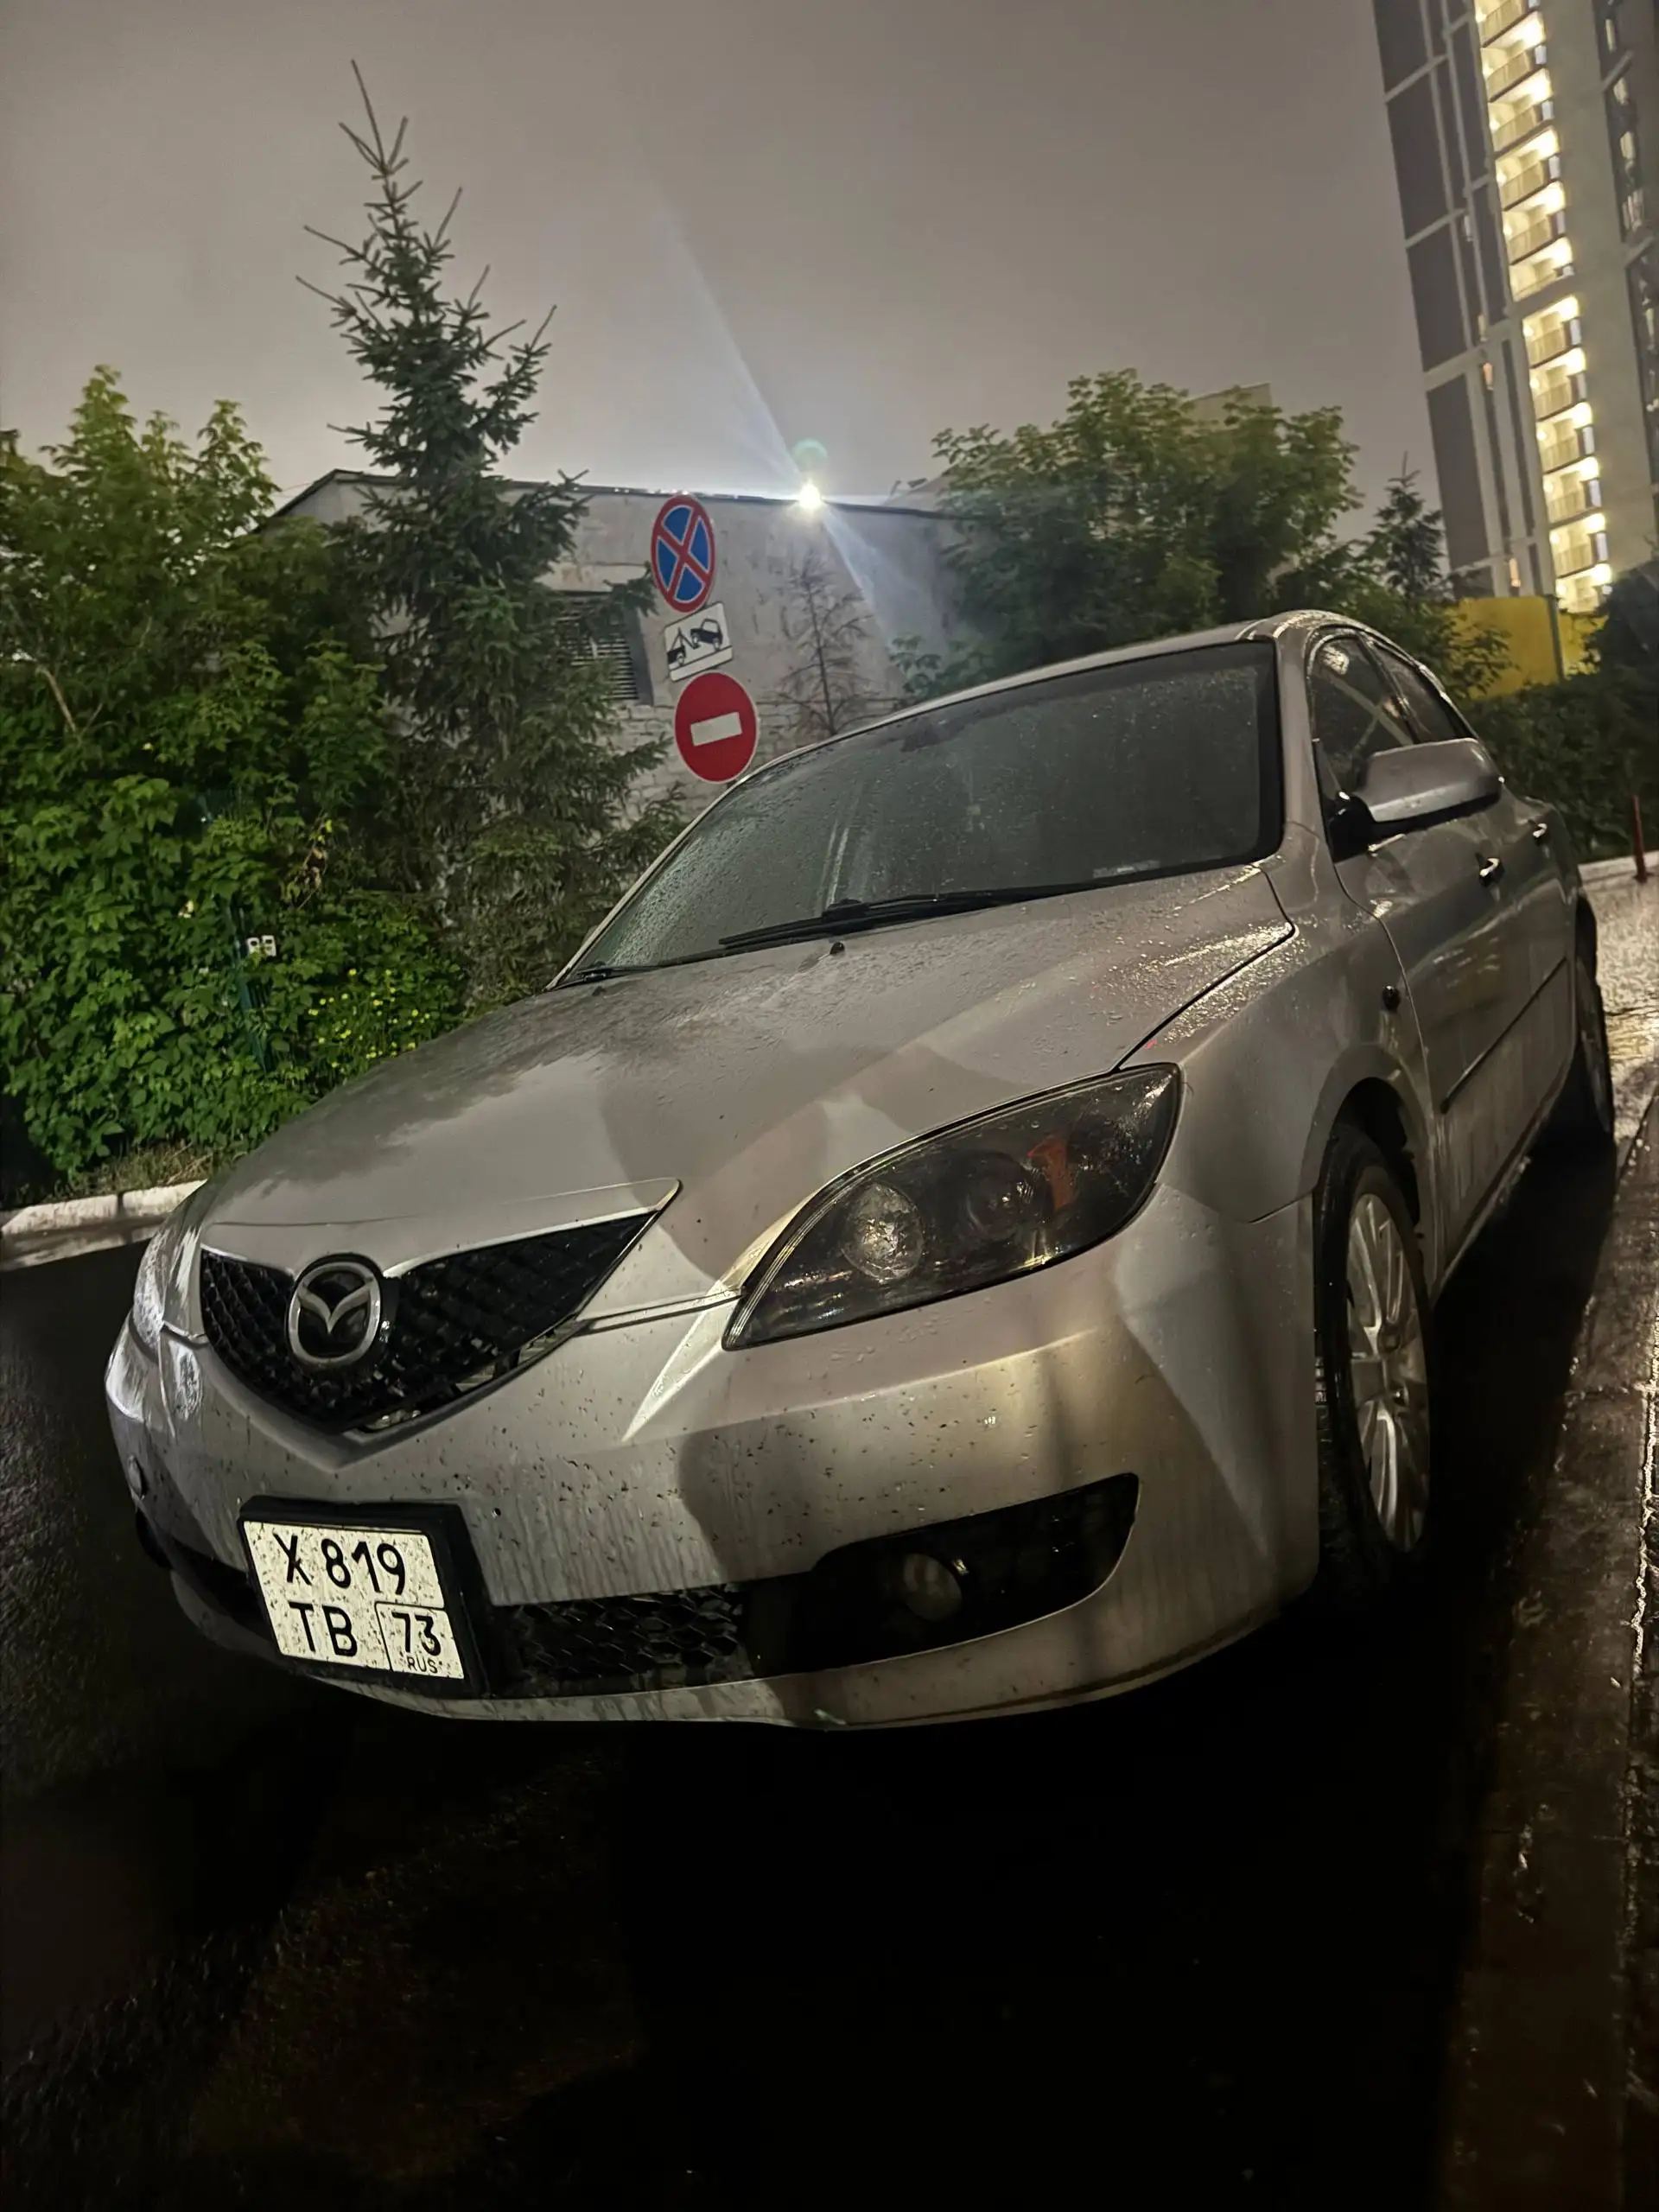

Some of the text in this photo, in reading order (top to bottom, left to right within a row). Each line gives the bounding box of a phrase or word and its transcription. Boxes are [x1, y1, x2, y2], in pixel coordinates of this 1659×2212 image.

[273, 1532, 406, 1596] Х 819
[288, 1601, 358, 1657] ТВ
[392, 1611, 442, 1656] 73
[407, 1656, 438, 1674] RUS
